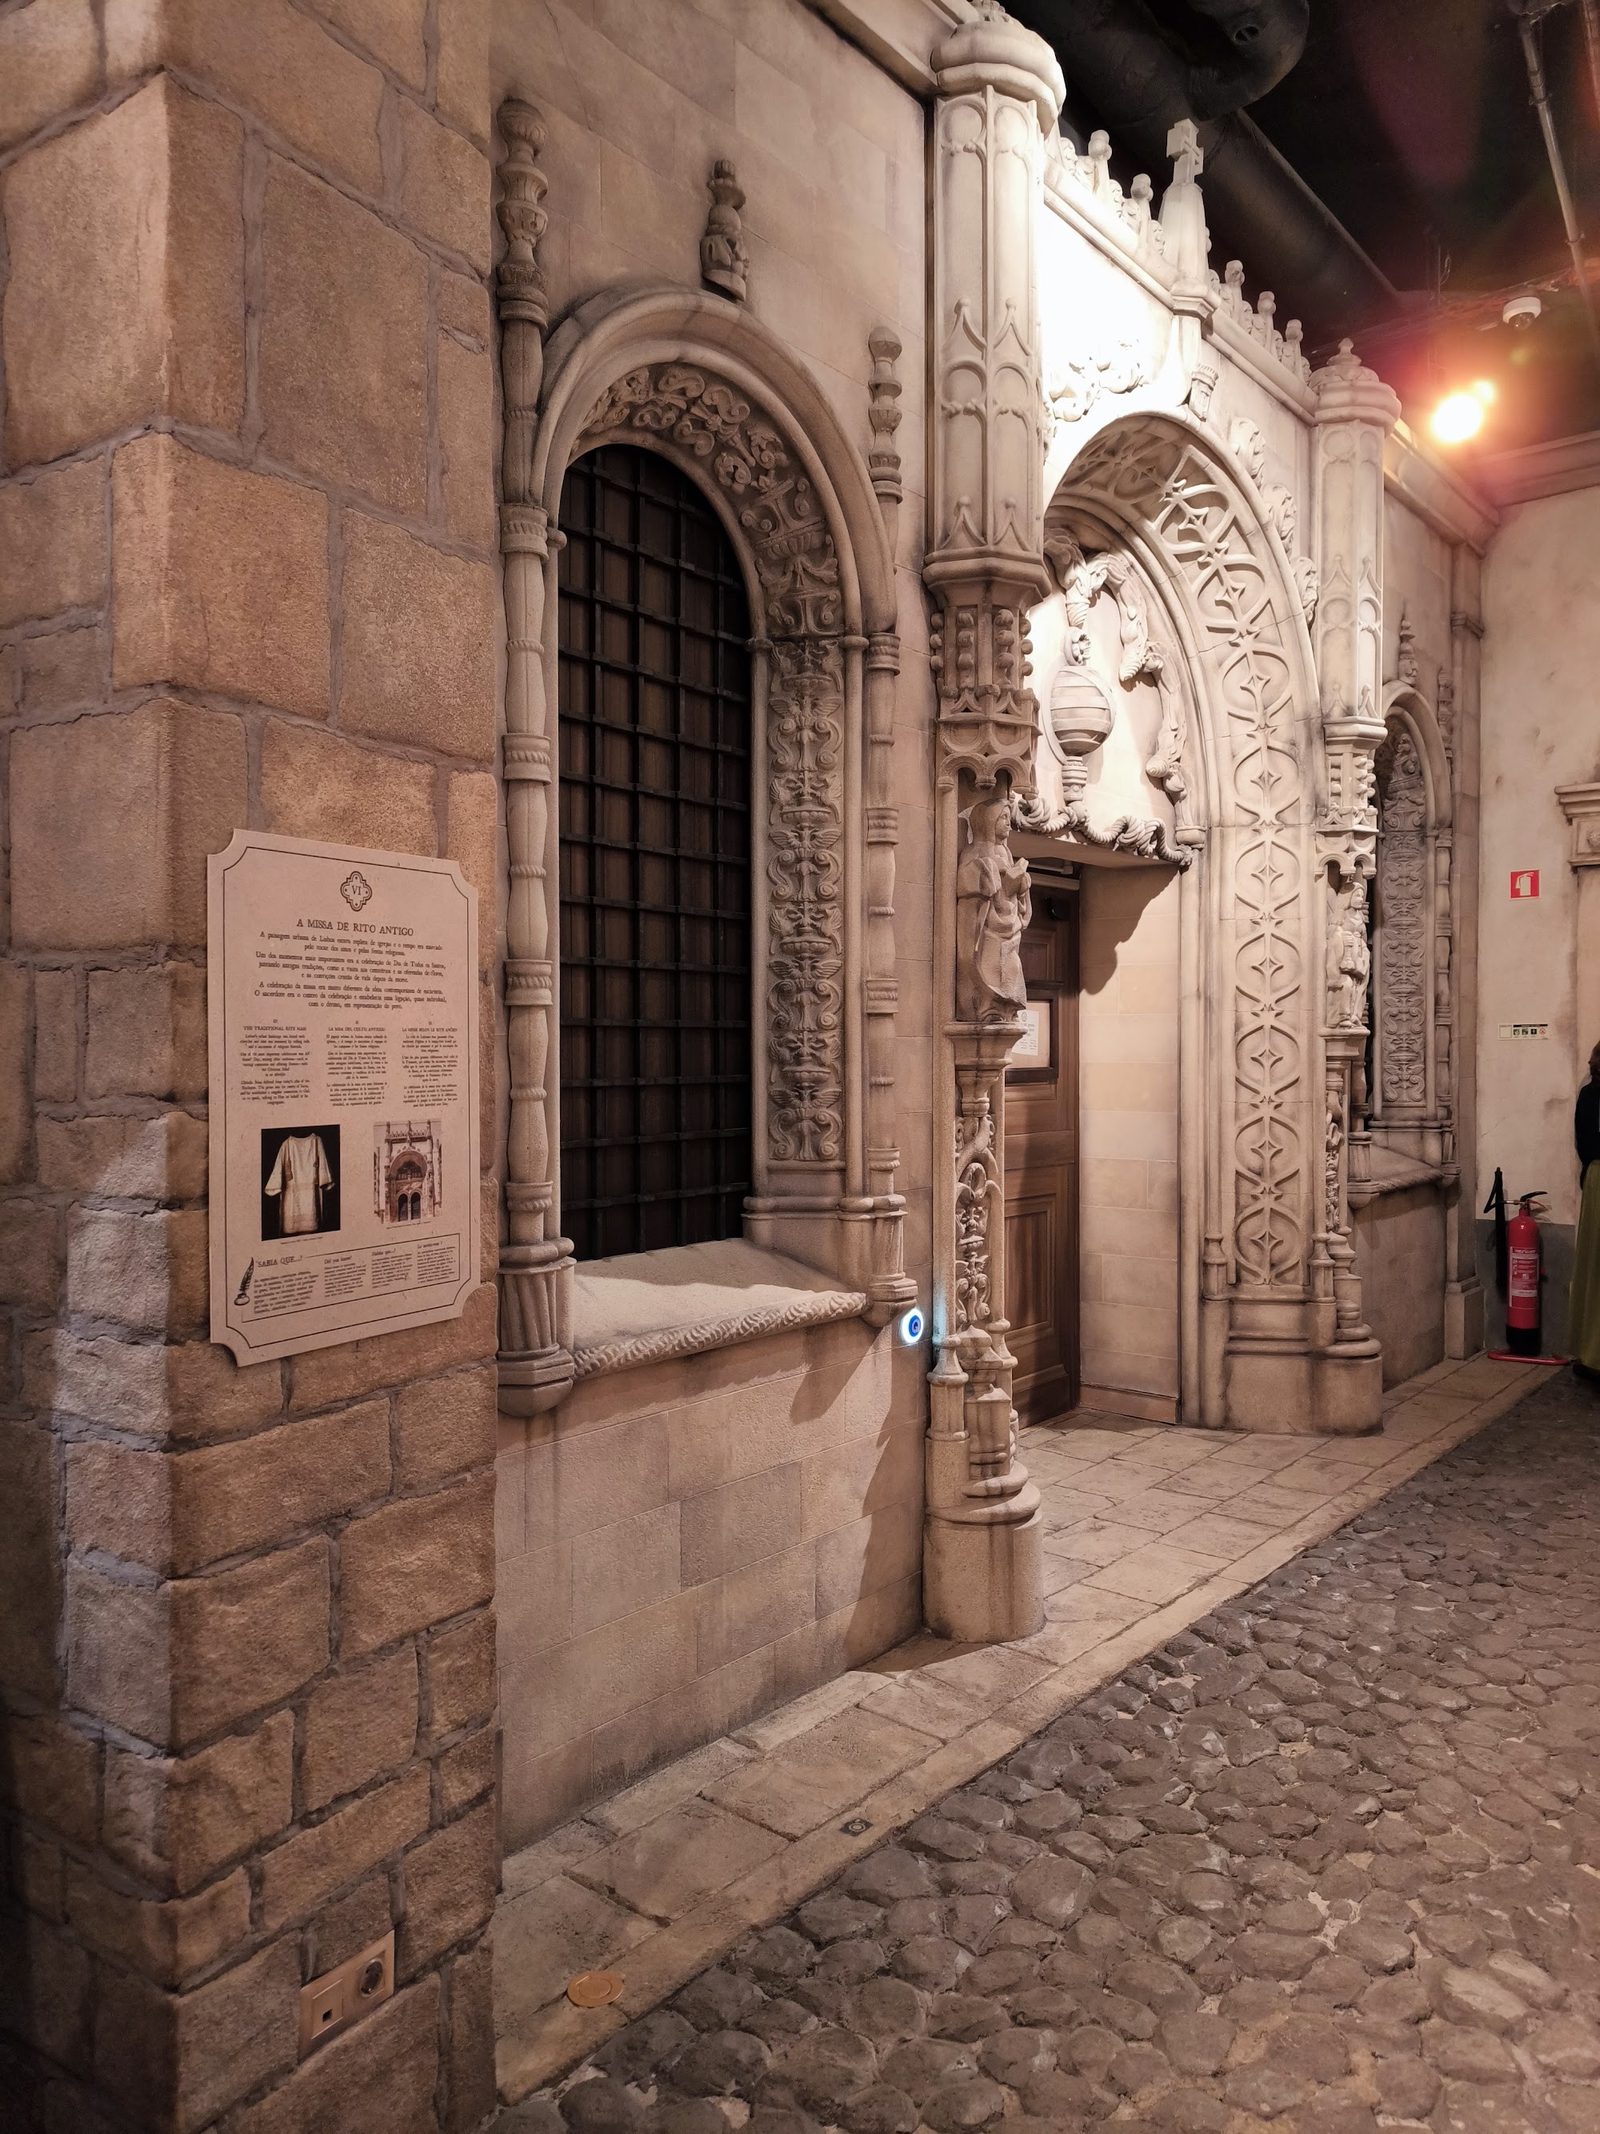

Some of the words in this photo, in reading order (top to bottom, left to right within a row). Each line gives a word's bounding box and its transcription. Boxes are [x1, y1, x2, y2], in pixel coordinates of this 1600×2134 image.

[352, 885, 361, 895] VI
[297, 919, 303, 927] A
[308, 919, 333, 930] MISSA
[337, 922, 349, 931] DE
[353, 923, 376, 933] RITO
[379, 926, 413, 936] ANTIGO
